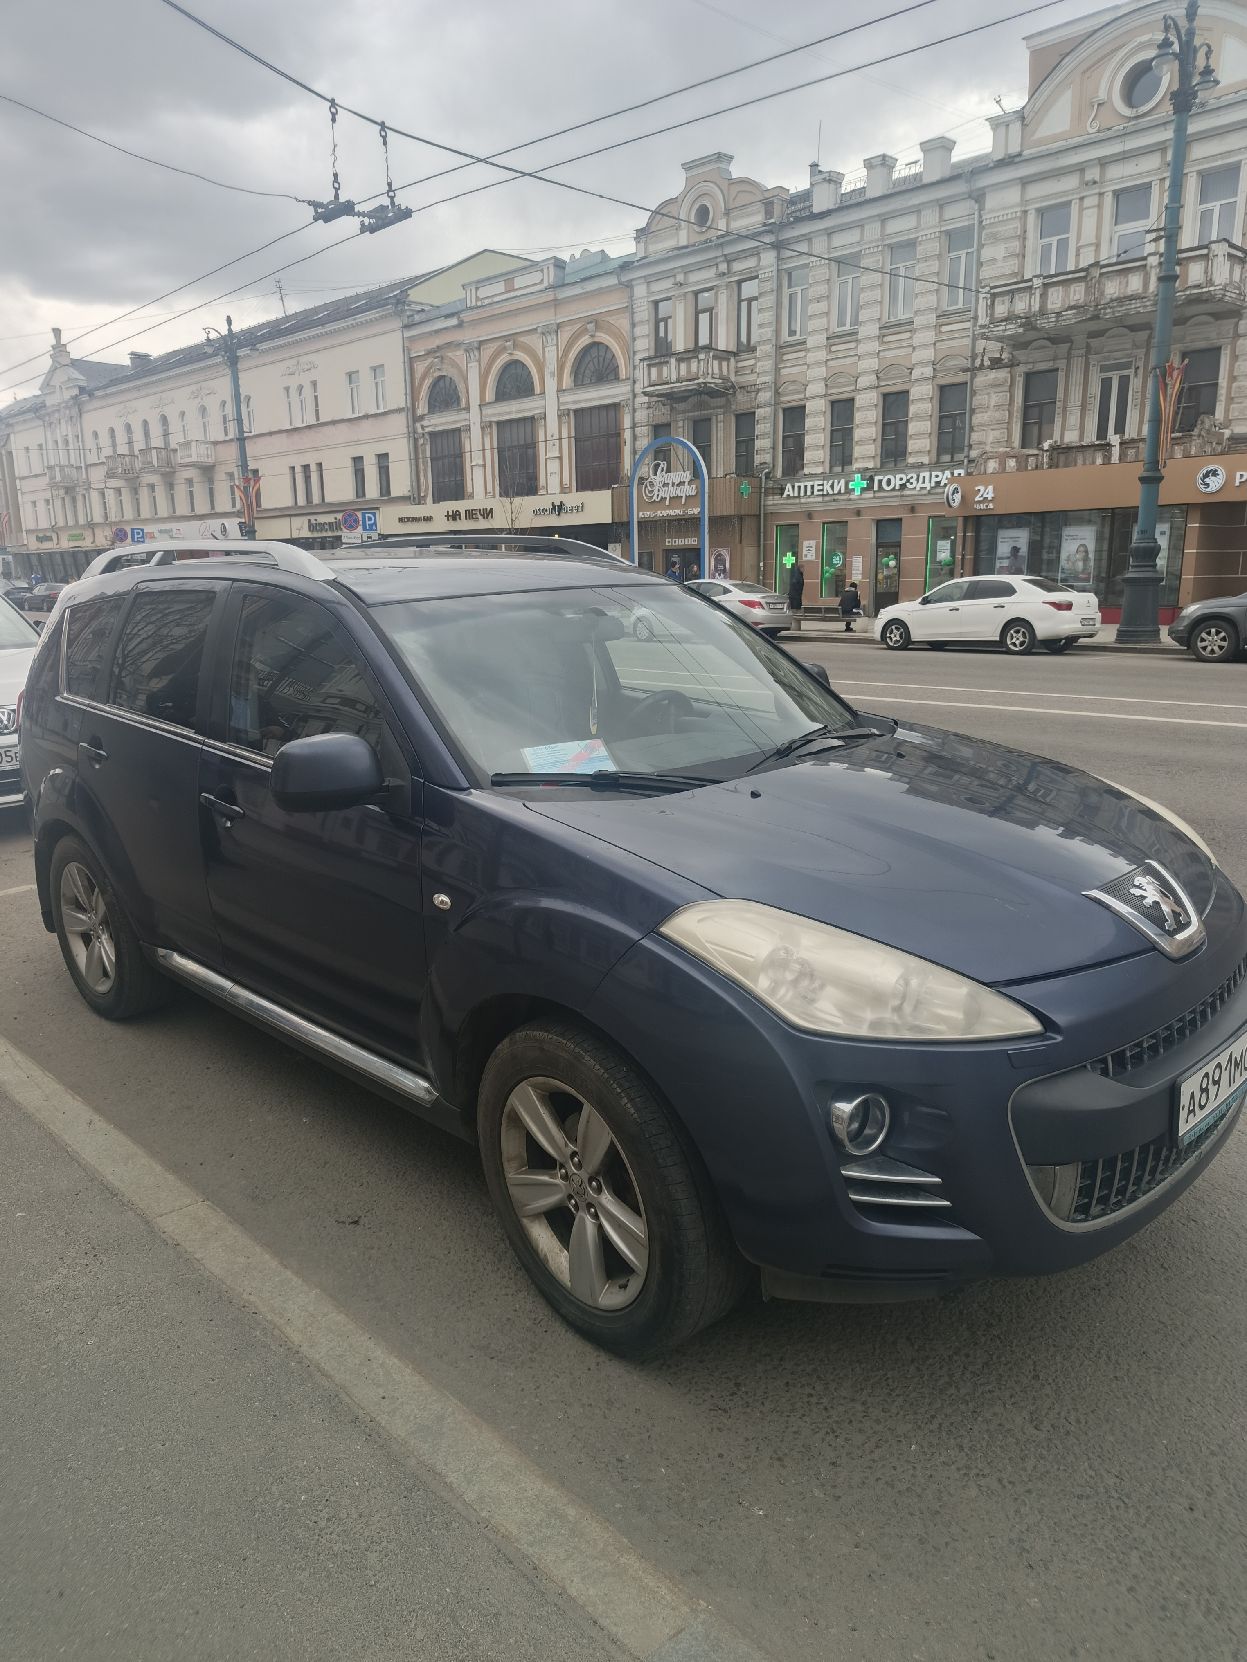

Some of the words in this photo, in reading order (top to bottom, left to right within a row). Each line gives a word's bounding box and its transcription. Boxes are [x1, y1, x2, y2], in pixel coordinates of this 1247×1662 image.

[783, 479, 845, 498] АПТЕКИ
[974, 485, 995, 501] 24
[464, 507, 494, 521] ПЕЧИ
